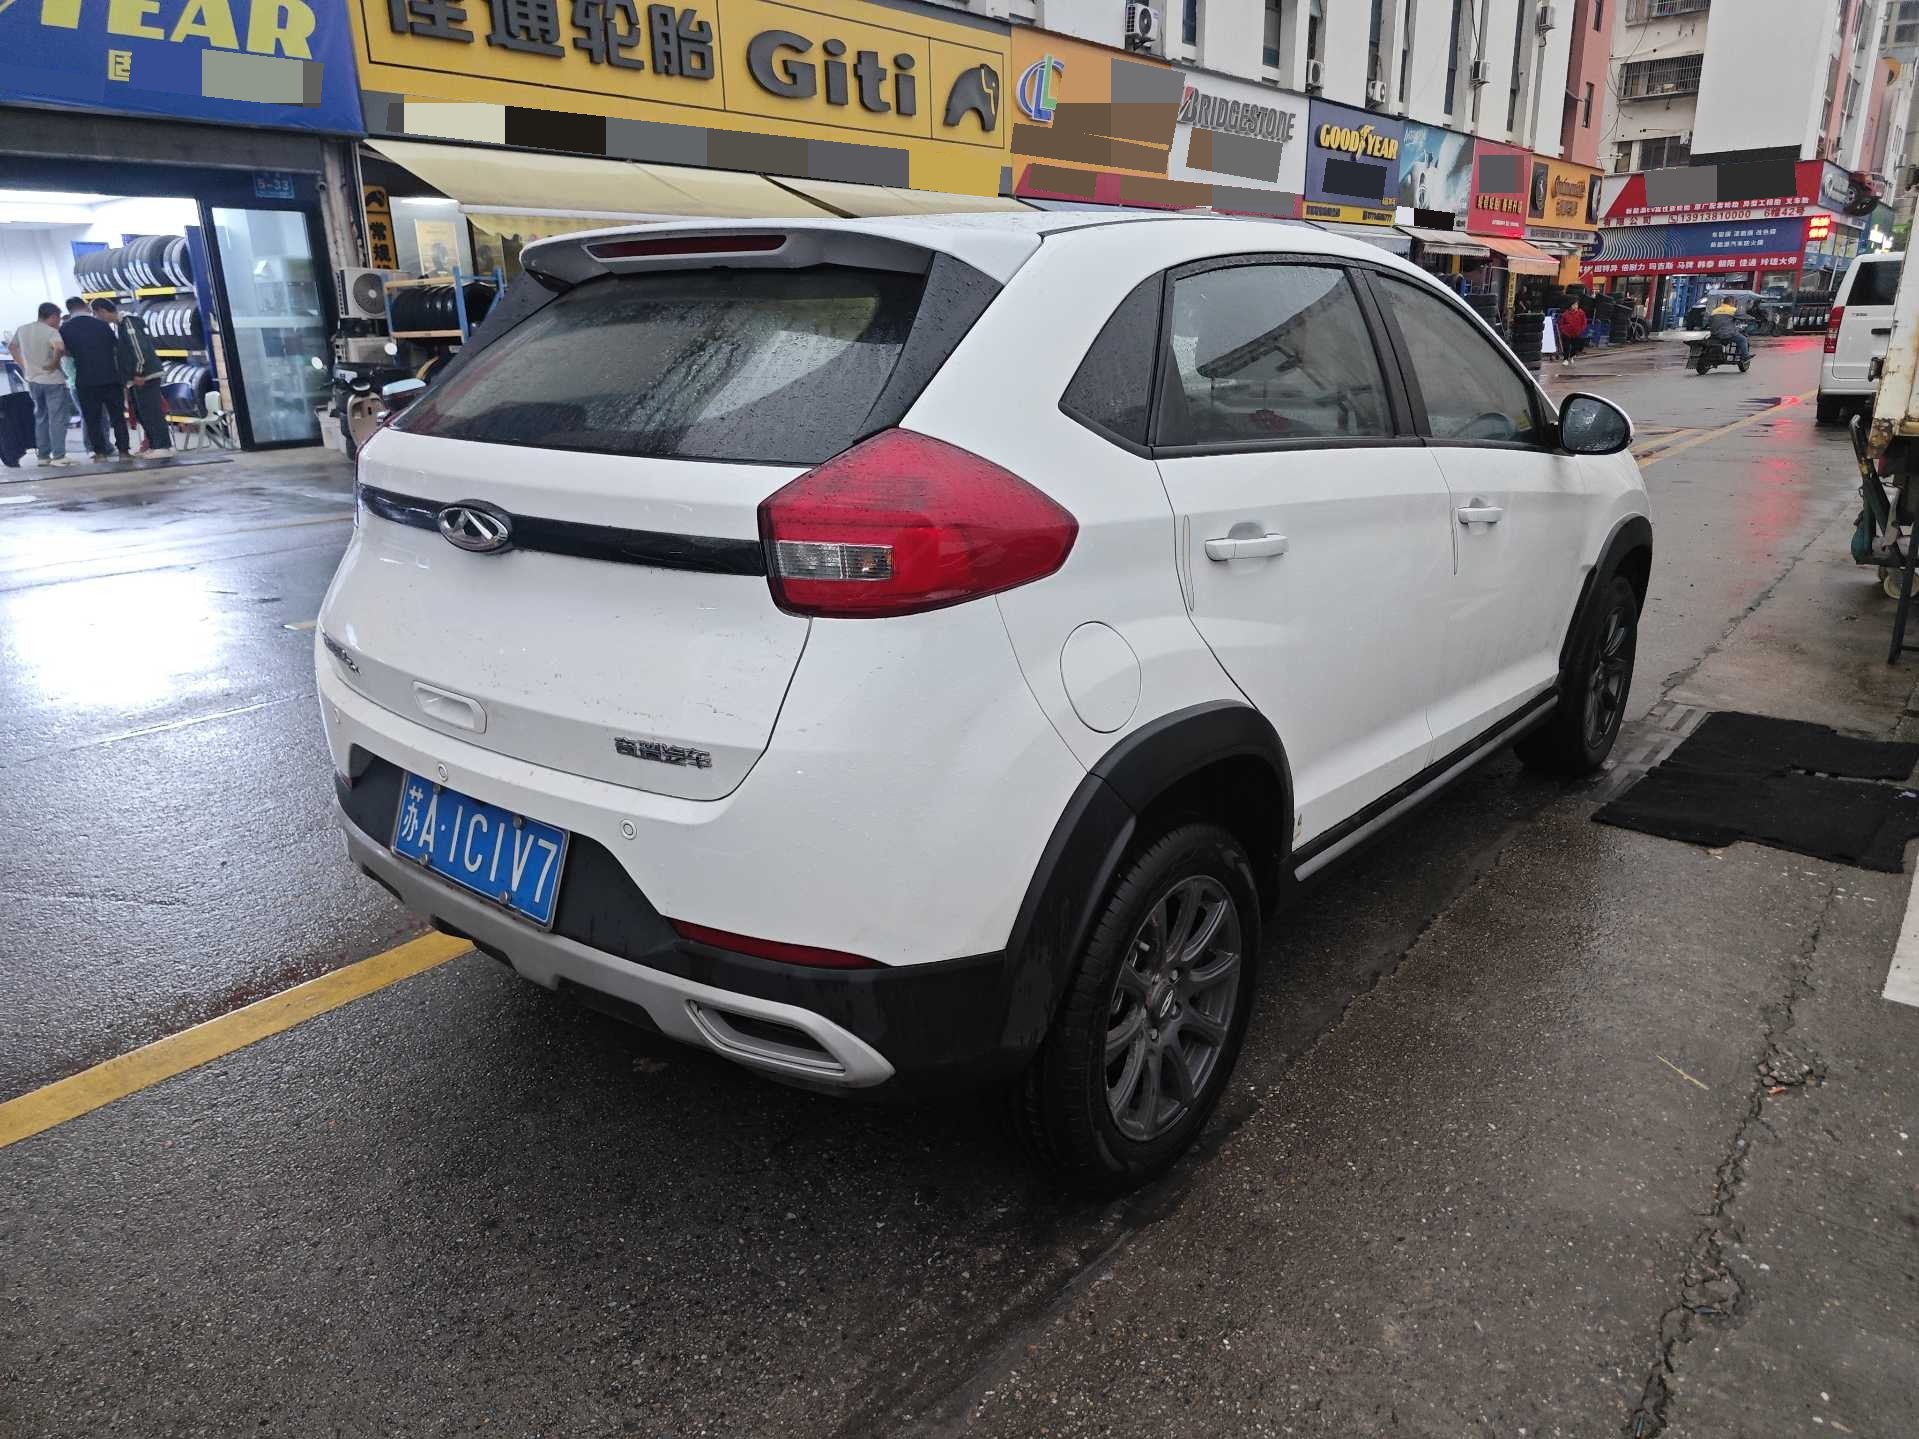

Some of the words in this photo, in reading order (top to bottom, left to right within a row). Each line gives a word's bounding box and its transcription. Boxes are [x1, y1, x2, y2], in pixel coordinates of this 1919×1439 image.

[746, 29, 916, 117] Giti
[1177, 86, 1296, 142] BRIDGESTONE
[1318, 123, 1399, 161] GOODYEAR
[1680, 209, 1751, 222] 13913810000
[369, 221, 394, 269] 常规
[1621, 262, 1645, 272] 倍耐力
[614, 736, 713, 770] 奇瑞汽车
